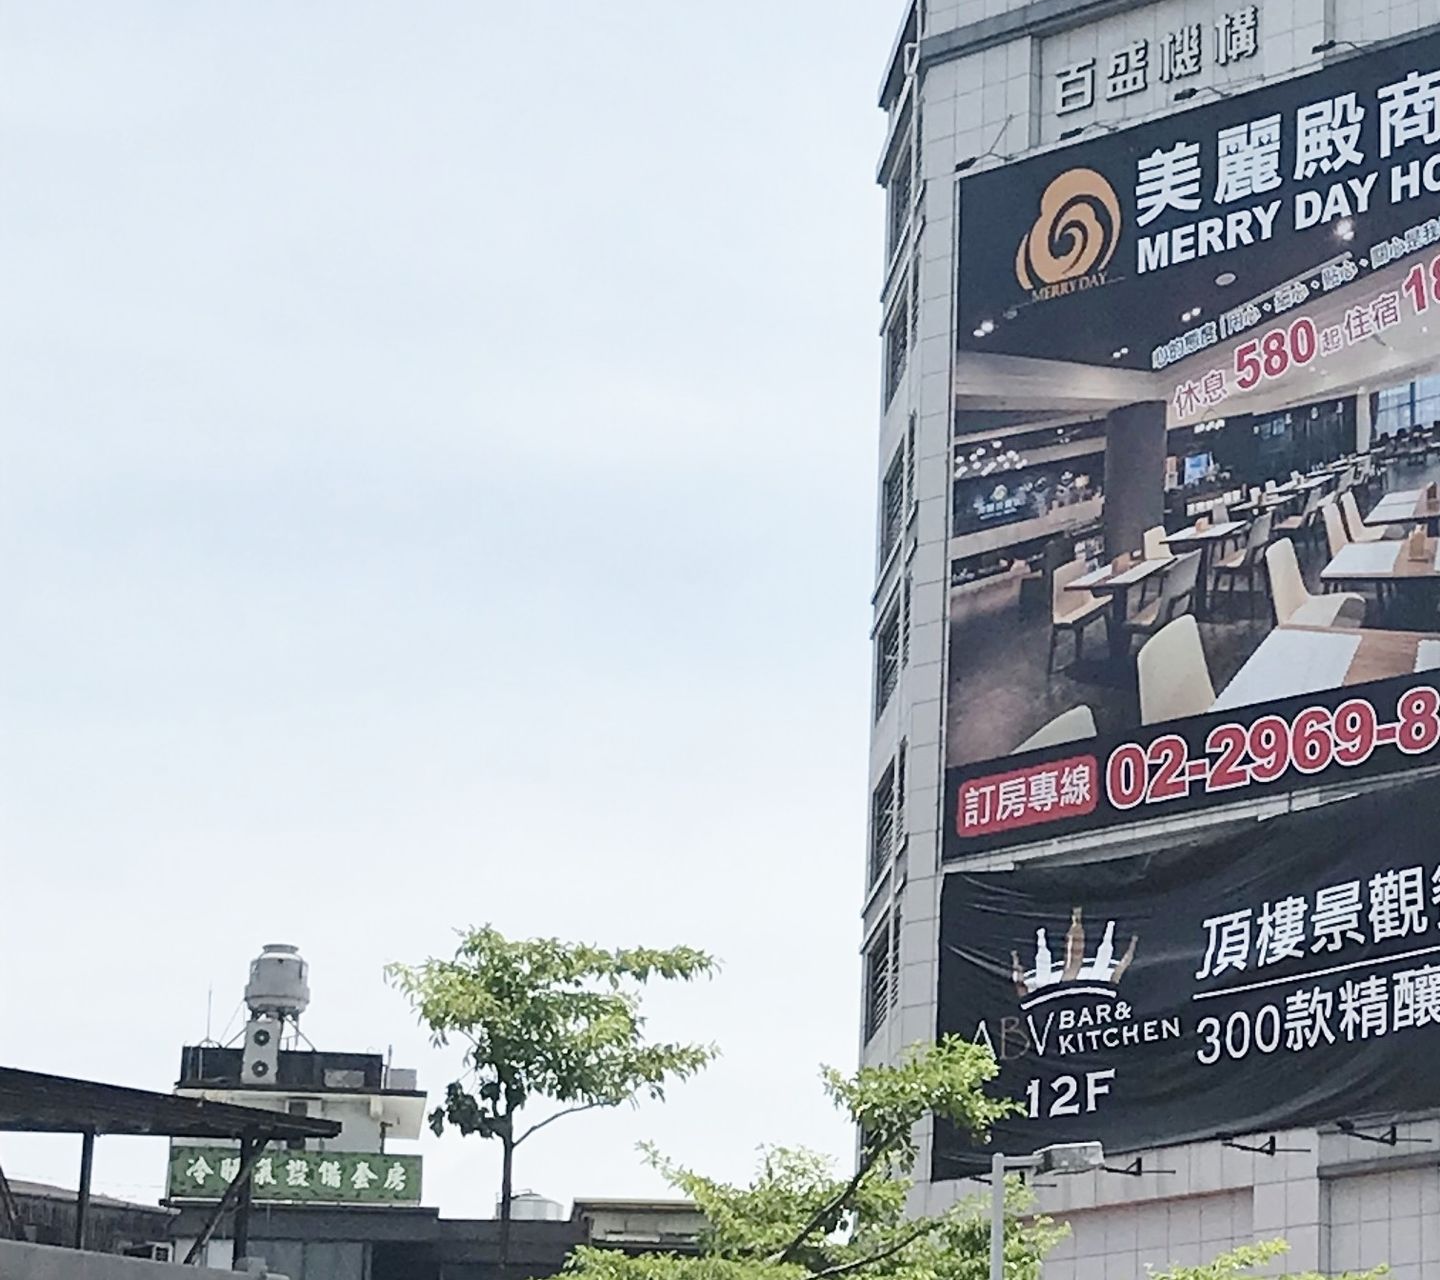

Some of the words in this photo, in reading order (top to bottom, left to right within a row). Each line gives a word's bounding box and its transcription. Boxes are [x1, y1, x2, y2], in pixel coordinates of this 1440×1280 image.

[1055, 5, 1259, 118] 百盛機構
[1137, 199, 1282, 274] MERRY
[1295, 168, 1376, 230] DAY
[1032, 279, 1077, 301] MERRY
[1080, 271, 1107, 290] DAY
[963, 764, 1092, 828] 訂房專線
[1059, 1017, 1181, 1056] KITCHEN
[1026, 1068, 1116, 1119] 12F
